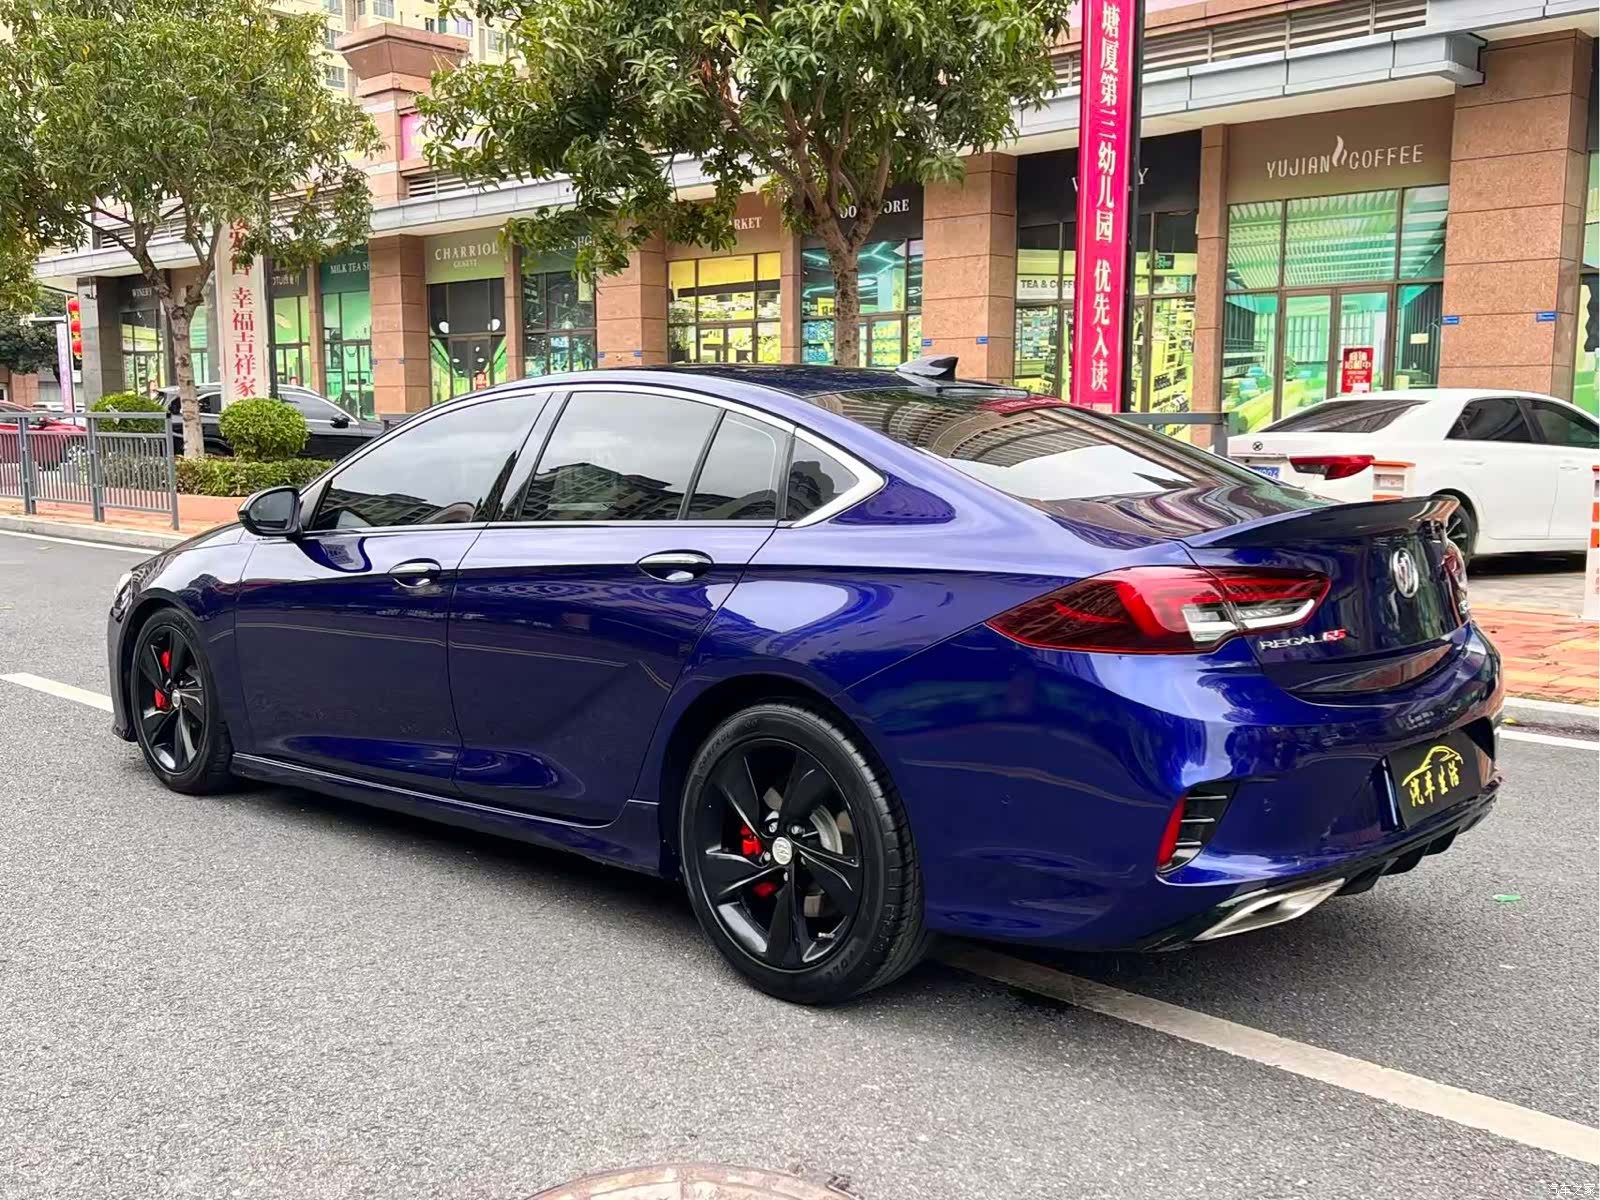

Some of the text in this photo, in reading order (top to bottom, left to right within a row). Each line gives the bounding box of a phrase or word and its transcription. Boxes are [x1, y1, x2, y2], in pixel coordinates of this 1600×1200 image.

[1266, 144, 1424, 179] YUJIAN COFFEE
[1091, 1, 1120, 392] 塘厦第三幼儿园 优先入读
[434, 241, 499, 261] CHARRIOL
[330, 263, 347, 274] MILK
[348, 262, 361, 273] TEA
[1020, 279, 1039, 289] TEA
[1040, 279, 1048, 289] &
[232, 287, 257, 398] 幸福吉祥家
[1259, 634, 1323, 650] REGAL
